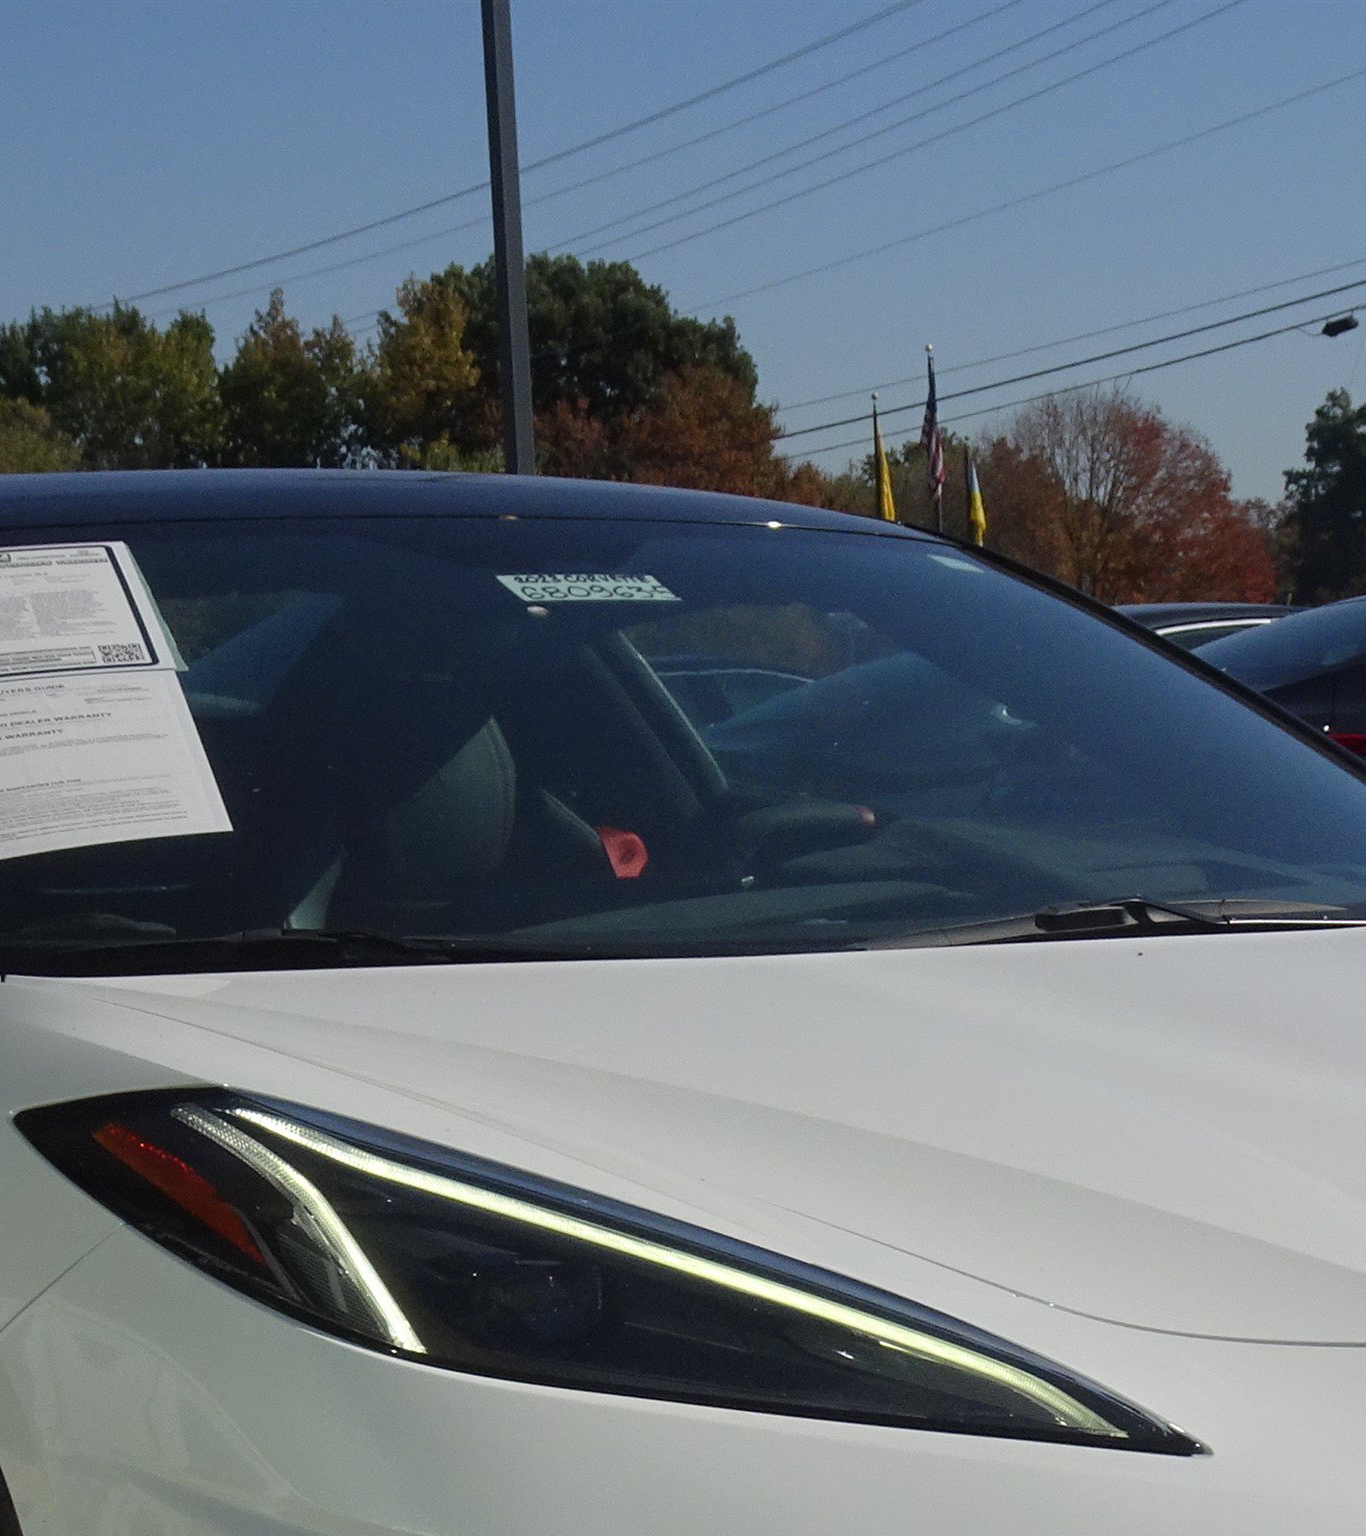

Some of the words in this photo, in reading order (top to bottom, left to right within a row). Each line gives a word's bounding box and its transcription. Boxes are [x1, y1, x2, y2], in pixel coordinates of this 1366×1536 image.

[521, 585, 676, 600] 6809635
[10, 717, 51, 727] DEALER
[54, 712, 112, 723] WARRANTY
[5, 729, 64, 740] WARRANTY
